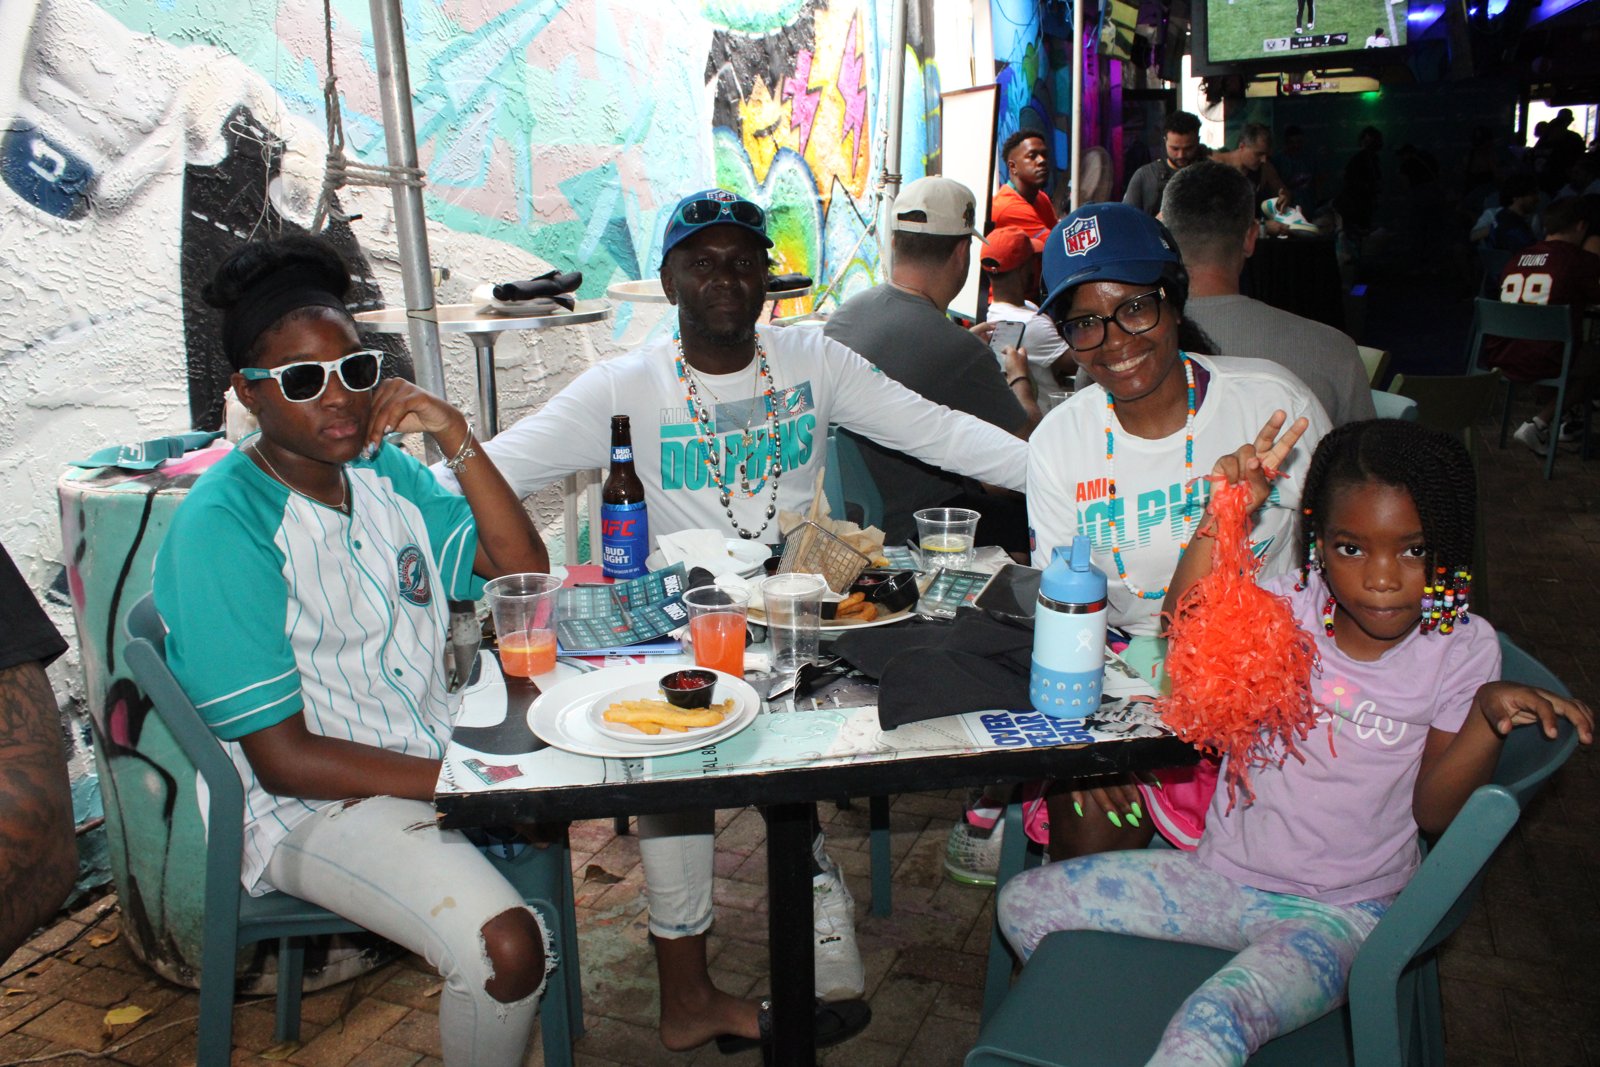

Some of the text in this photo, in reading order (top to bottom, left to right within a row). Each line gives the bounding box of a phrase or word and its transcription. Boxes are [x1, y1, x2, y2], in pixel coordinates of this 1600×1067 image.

[1324, 35, 1331, 43] 7
[1066, 228, 1096, 253] NFL
[1517, 253, 1549, 267] YOUNG
[660, 403, 716, 425] MIAI
[660, 413, 816, 491] DOLPHNS
[603, 552, 630, 564] LIGHT
[605, 546, 625, 556] BUD
[980, 712, 1027, 746] OVER
[1014, 713, 1063, 747] FEAR
